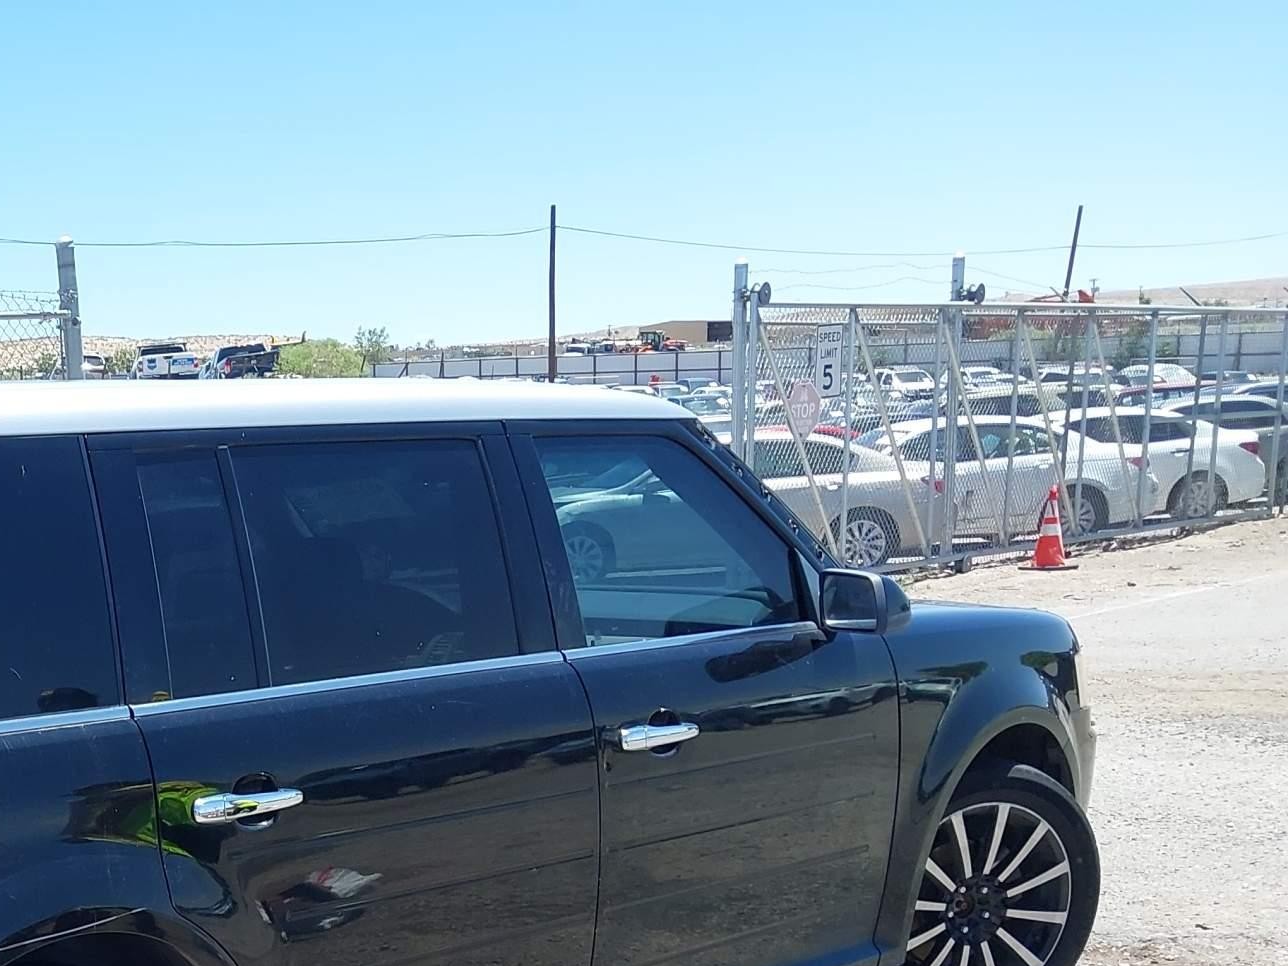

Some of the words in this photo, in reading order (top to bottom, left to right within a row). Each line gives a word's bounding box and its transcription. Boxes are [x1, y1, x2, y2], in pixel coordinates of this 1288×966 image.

[819, 331, 841, 343] SPEED
[820, 347, 838, 359] LIMIT
[822, 364, 833, 390] 5
[792, 402, 816, 418] STOP
